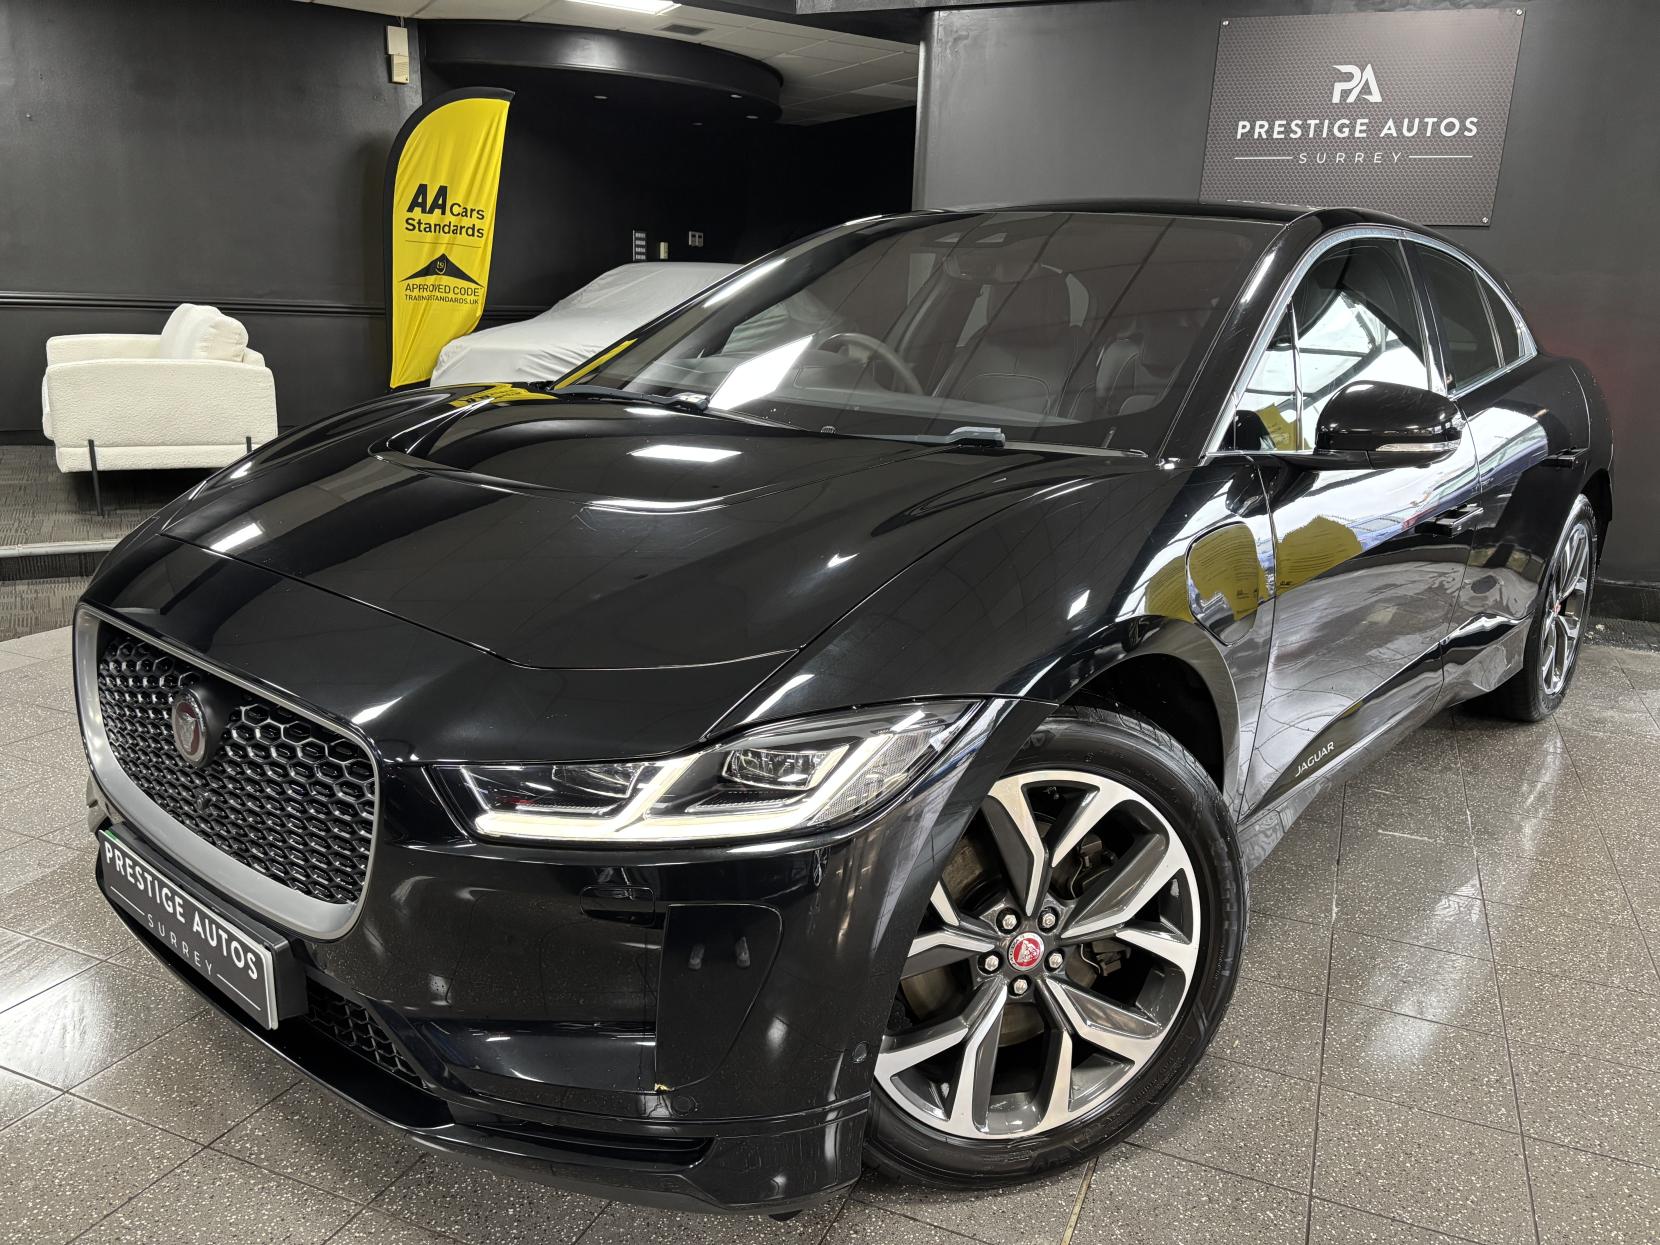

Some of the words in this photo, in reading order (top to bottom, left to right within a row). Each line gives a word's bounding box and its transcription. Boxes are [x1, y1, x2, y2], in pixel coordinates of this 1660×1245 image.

[1332, 64, 1382, 103] PA
[1237, 119, 1368, 139] PRESTIGE
[1380, 117, 1479, 138] AUTOS
[1299, 152, 1402, 164] SURREY
[406, 184, 448, 216] AA
[449, 202, 485, 219] Cars
[405, 217, 485, 238] Standards
[405, 283, 450, 294] APPROVED
[452, 286, 479, 297] CODE
[1295, 741, 1335, 777] JAGUAR
[104, 841, 185, 923] PRESTIGE
[193, 911, 258, 980] AUTOS
[147, 914, 213, 976] SURREY
